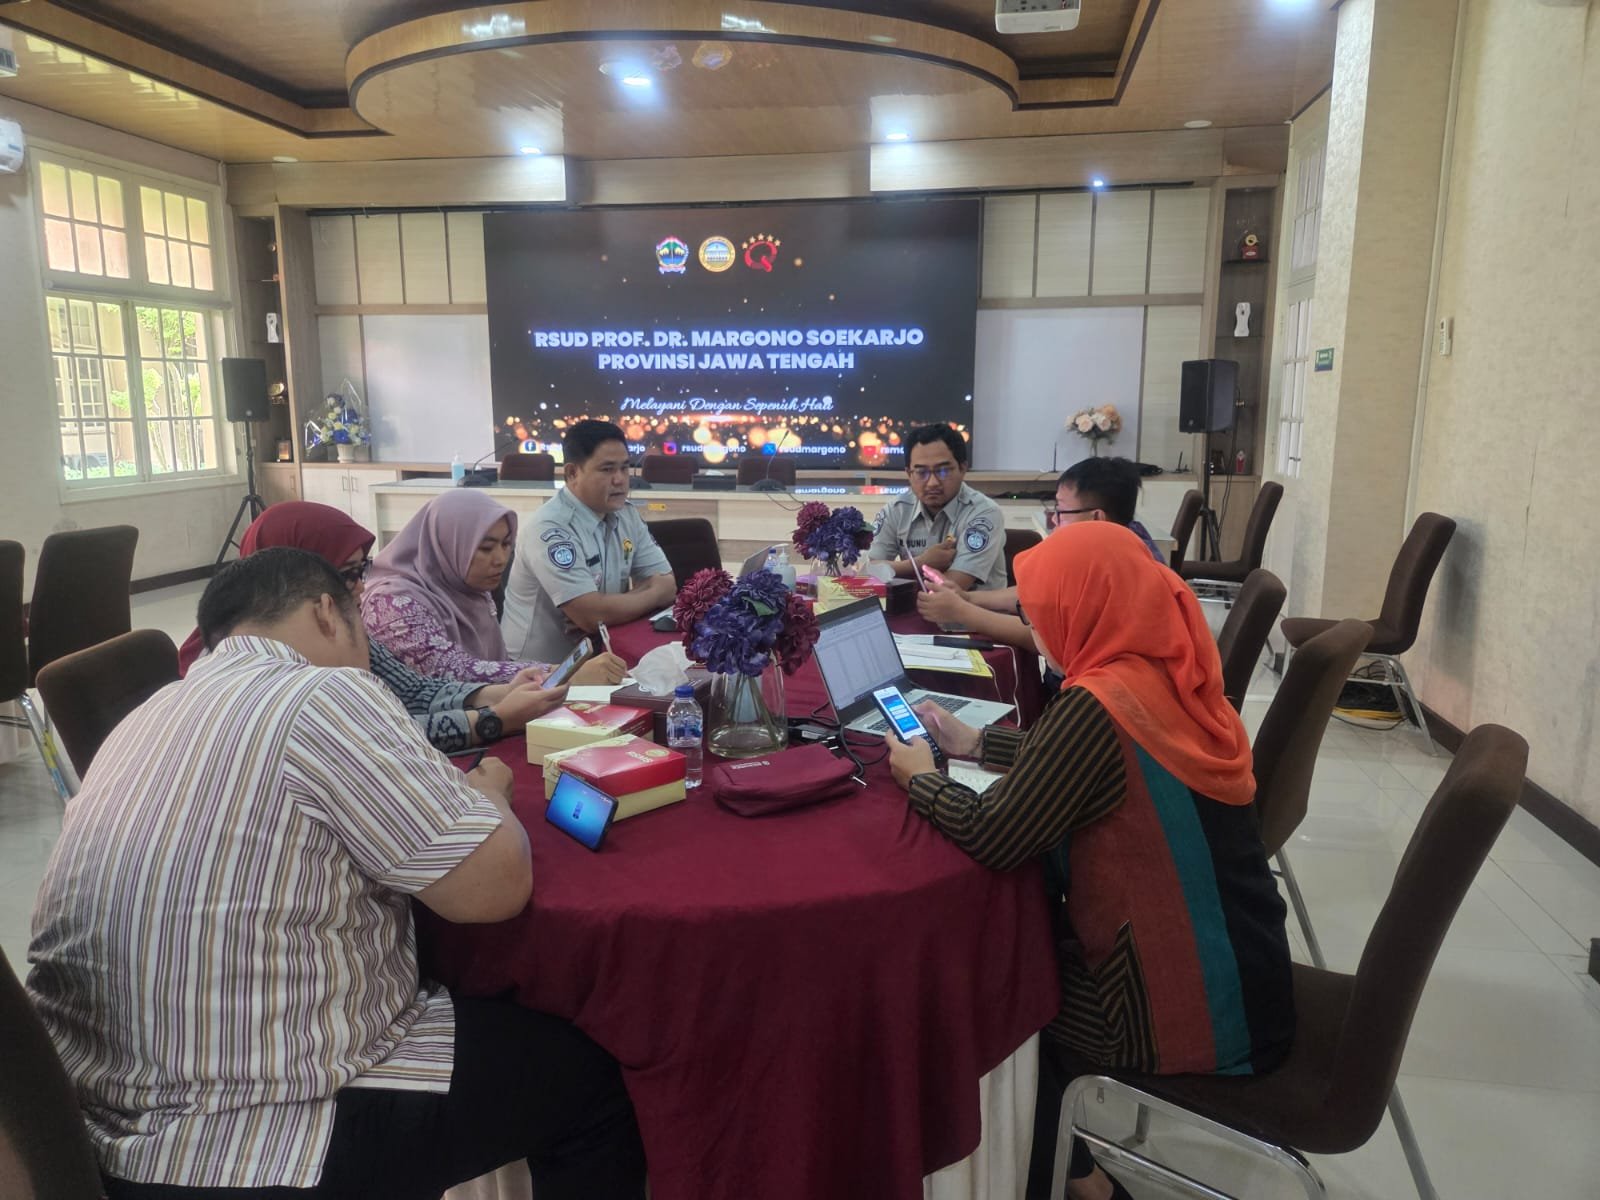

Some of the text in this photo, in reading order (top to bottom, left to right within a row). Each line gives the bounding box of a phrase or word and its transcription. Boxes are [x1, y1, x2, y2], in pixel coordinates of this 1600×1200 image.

[535, 328, 924, 348] RSUD PROF. DR. MARGONO SOEKARJO
[598, 352, 855, 370] PROVINSI JAWA TENGAH
[620, 397, 687, 415] Melayani
[688, 397, 742, 416] Dengan
[743, 396, 799, 415] Sepenuh
[681, 444, 746, 456] rsudgono
